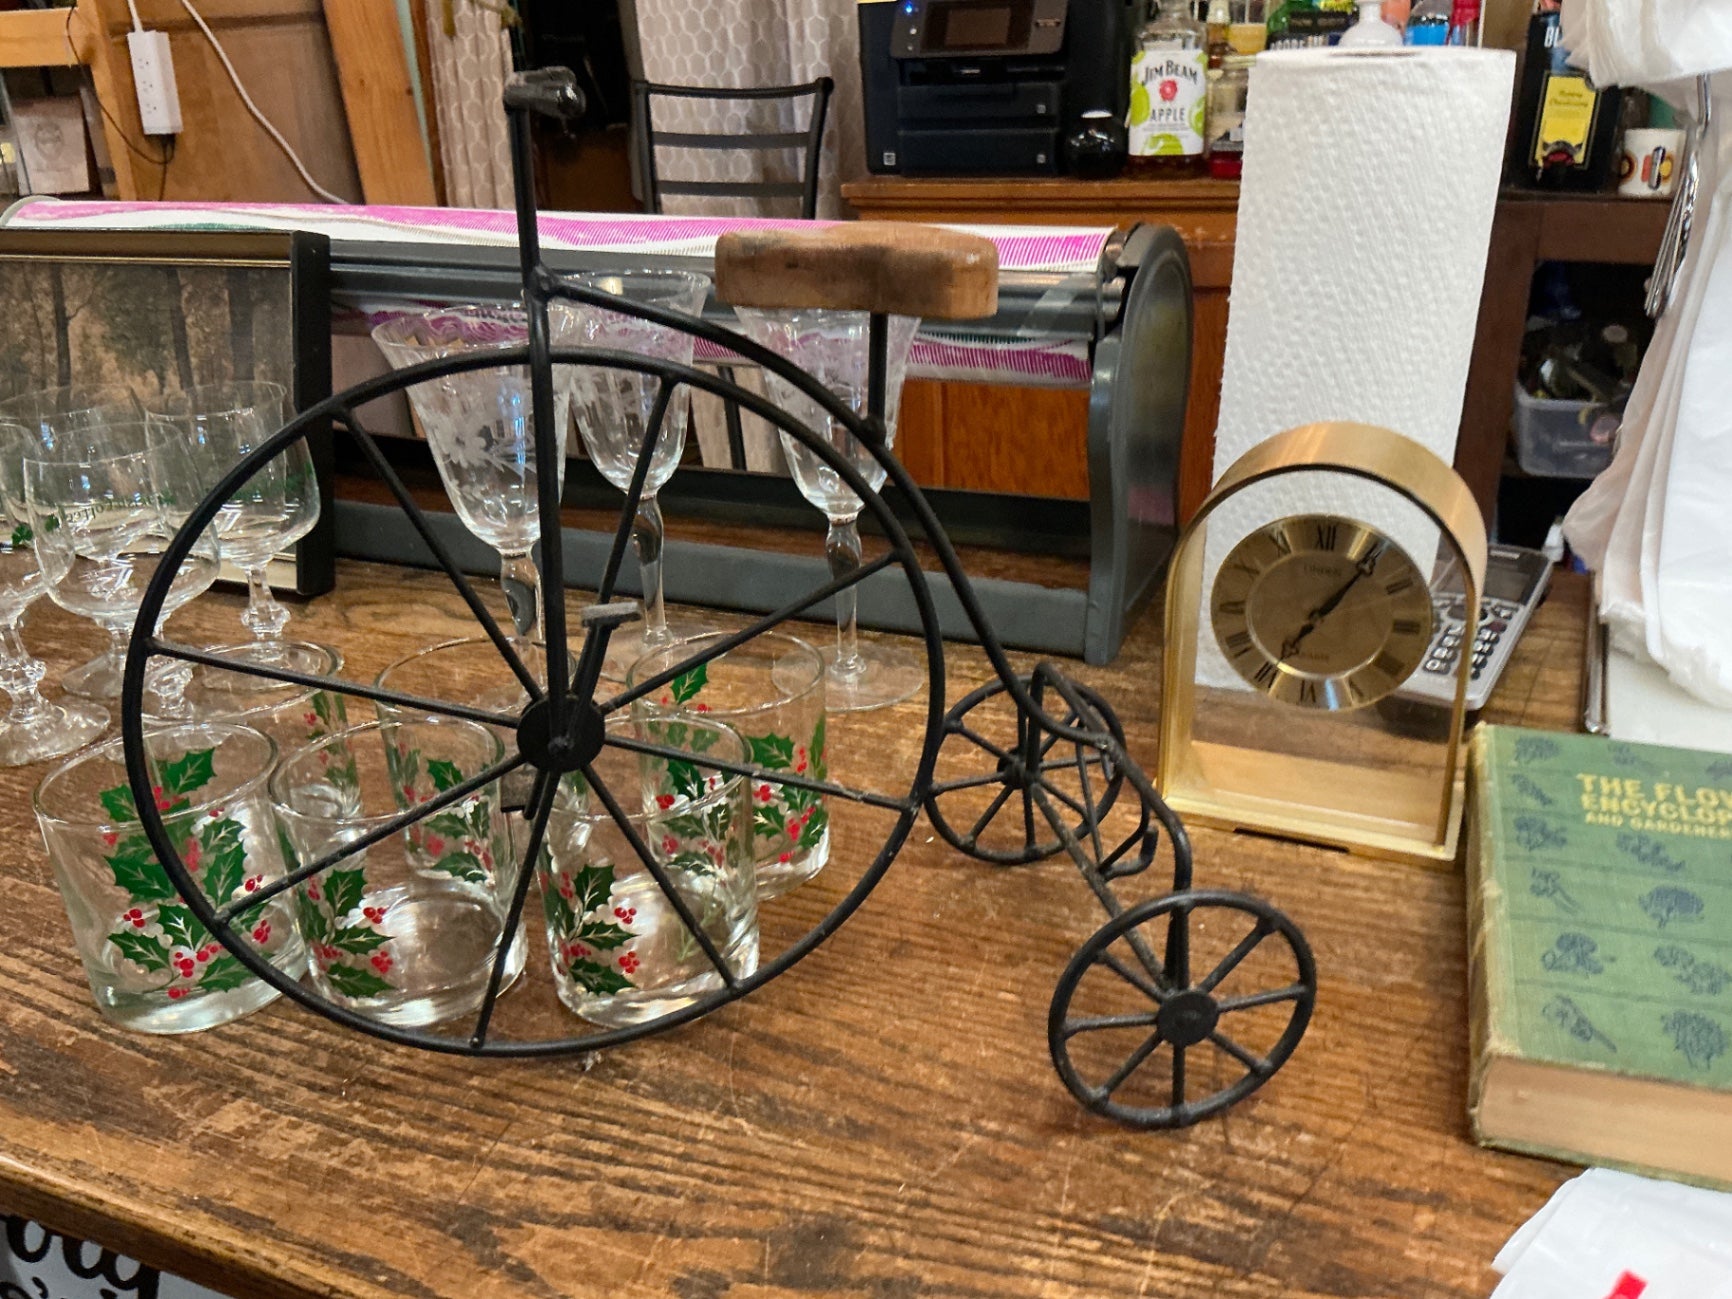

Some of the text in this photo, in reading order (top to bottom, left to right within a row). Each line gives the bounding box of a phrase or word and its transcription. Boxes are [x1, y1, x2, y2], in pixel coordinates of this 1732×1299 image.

[1141, 60, 1198, 86] JIM BEAM
[1150, 107, 1186, 121] APPLE
[1576, 772, 1645, 799] THE
[1584, 810, 1624, 828] AND
